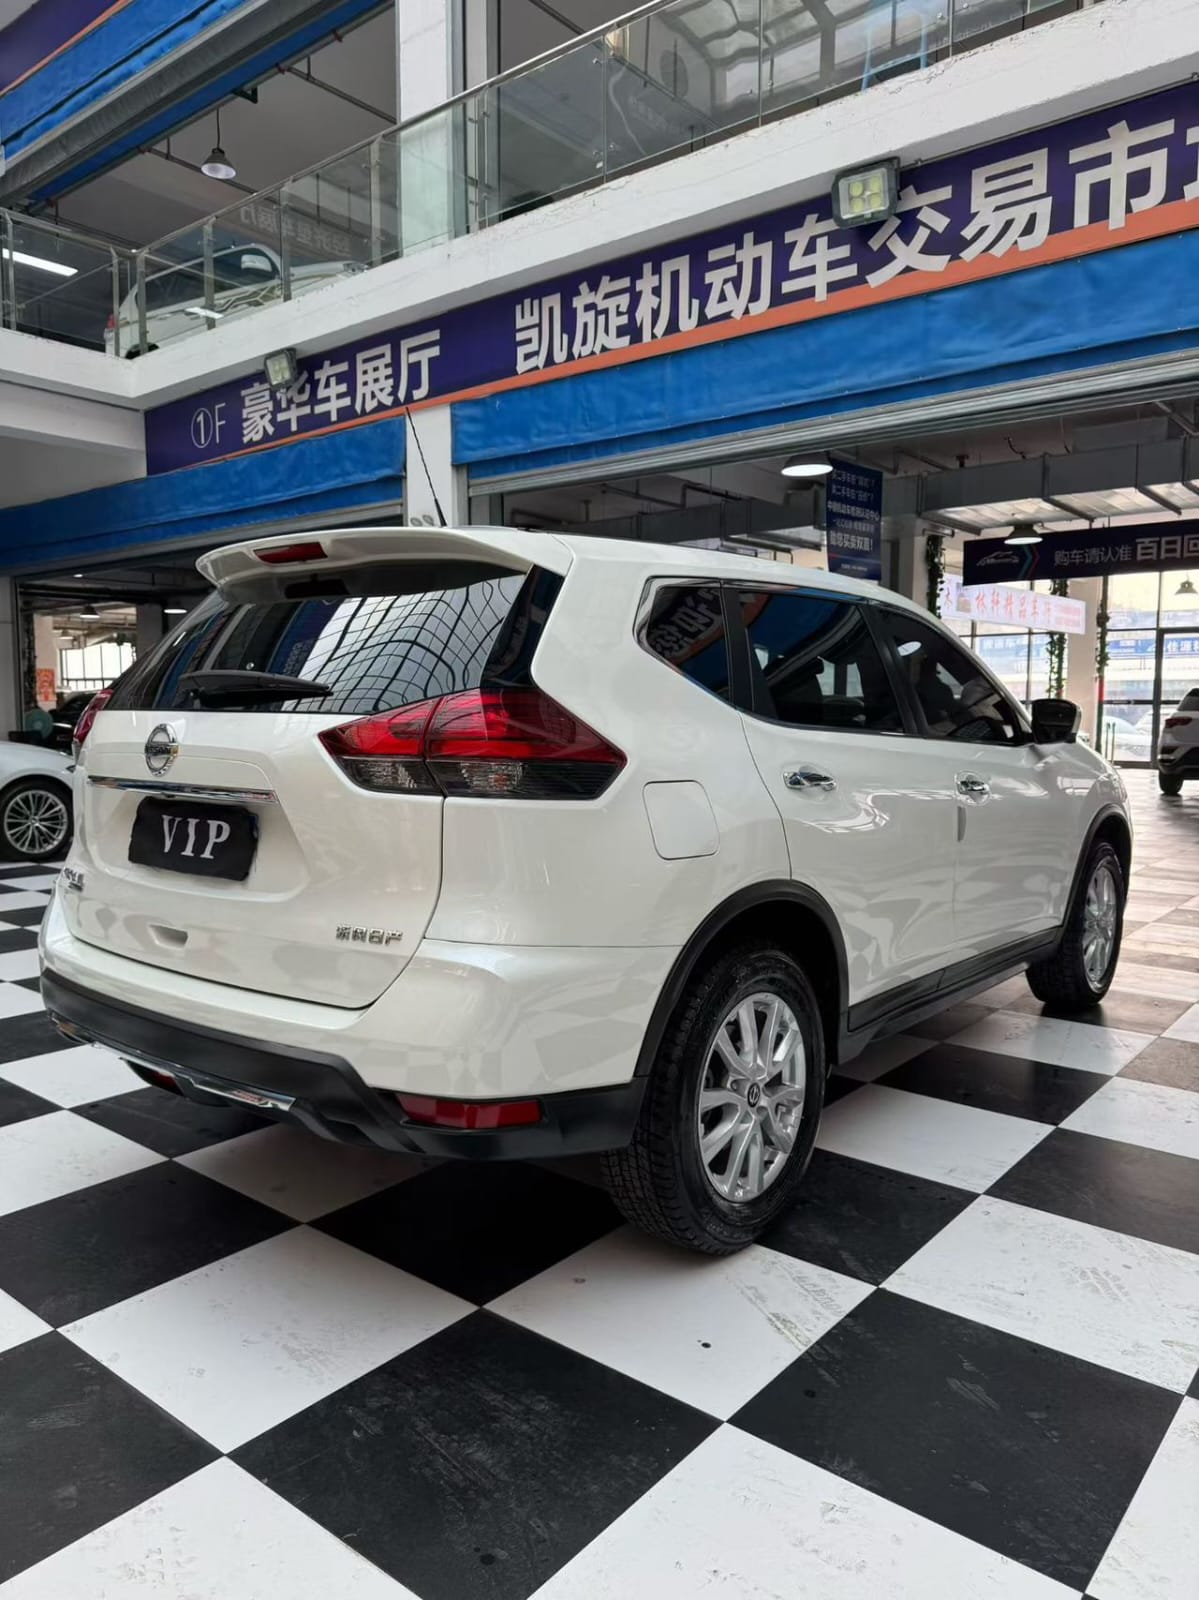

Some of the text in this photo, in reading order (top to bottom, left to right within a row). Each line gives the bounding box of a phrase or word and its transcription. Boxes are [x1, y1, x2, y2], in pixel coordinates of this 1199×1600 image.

[514, 120, 1199, 376] 凯旋机动车交易市
[240, 329, 441, 444] 豪华车展厅
[1054, 545, 1132, 567] 购车请认准
[161, 815, 230, 860] VIP
